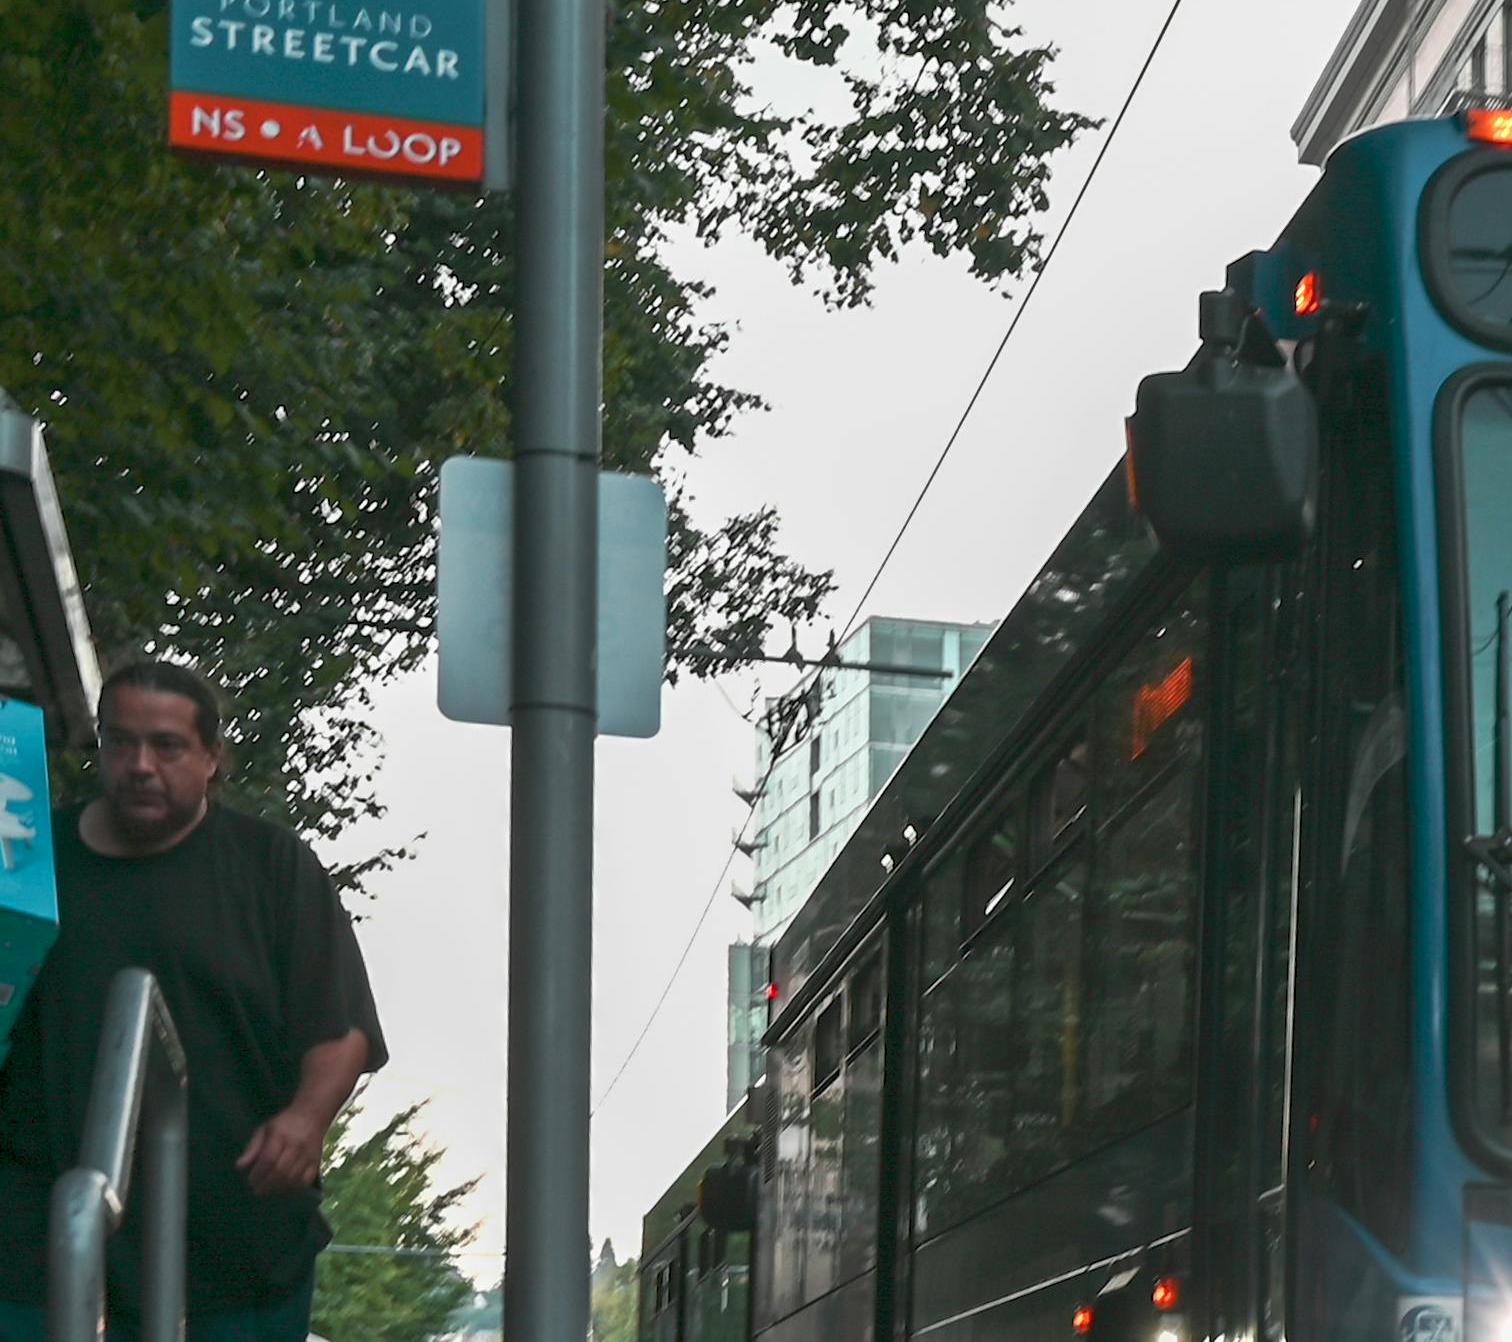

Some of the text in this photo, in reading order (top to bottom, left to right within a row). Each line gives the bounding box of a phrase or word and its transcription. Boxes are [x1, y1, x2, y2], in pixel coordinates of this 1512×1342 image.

[190, 16, 460, 79] STREETCAR
[191, 105, 463, 166] NS A LOOP
